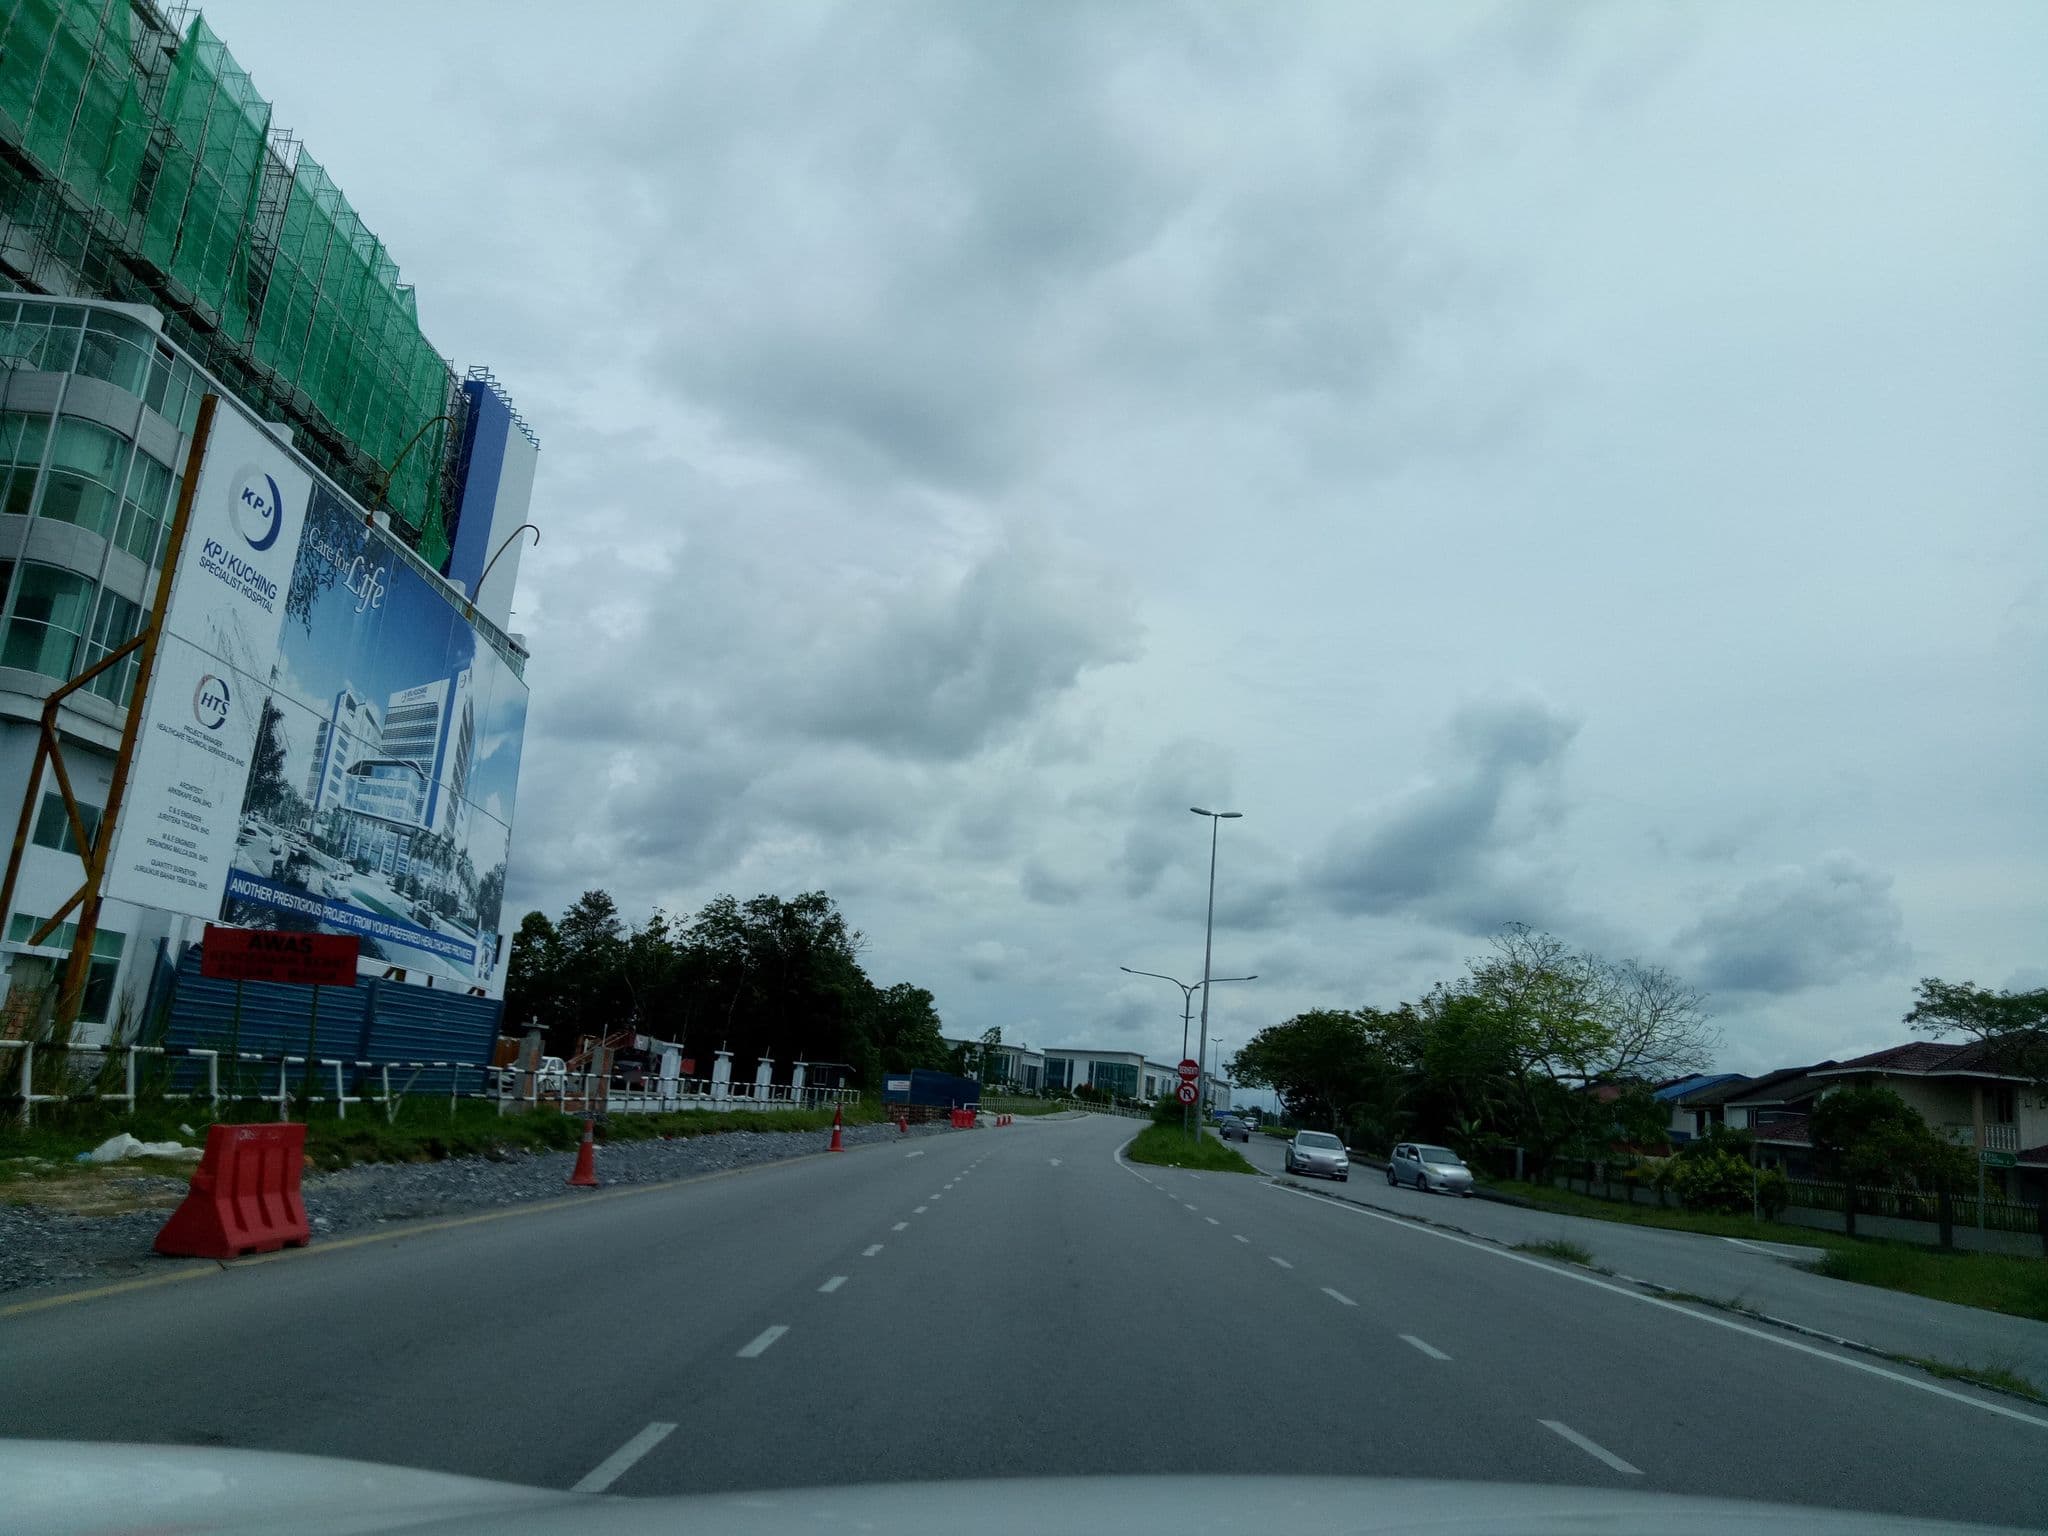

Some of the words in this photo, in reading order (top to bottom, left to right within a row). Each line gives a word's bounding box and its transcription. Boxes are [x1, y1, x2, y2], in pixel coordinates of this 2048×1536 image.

[241, 487, 272, 518] KPJ
[199, 556, 243, 593] SPECIALIST
[241, 584, 273, 614] HOSPITAL
[203, 538, 229, 565] KPJ
[227, 554, 278, 600] KUCHING
[309, 527, 334, 561] Care
[334, 548, 350, 575] for
[342, 556, 385, 613] Life
[200, 692, 230, 716] HTS
[230, 877, 273, 903] ANOTHER
[272, 891, 322, 916] PRESTIGIOUS
[322, 905, 354, 924] PROJECT
[353, 914, 372, 931] FROM
[372, 920, 389, 936] YOUR
[389, 925, 421, 943] PREFERRED
[249, 934, 313, 954] AWAS
